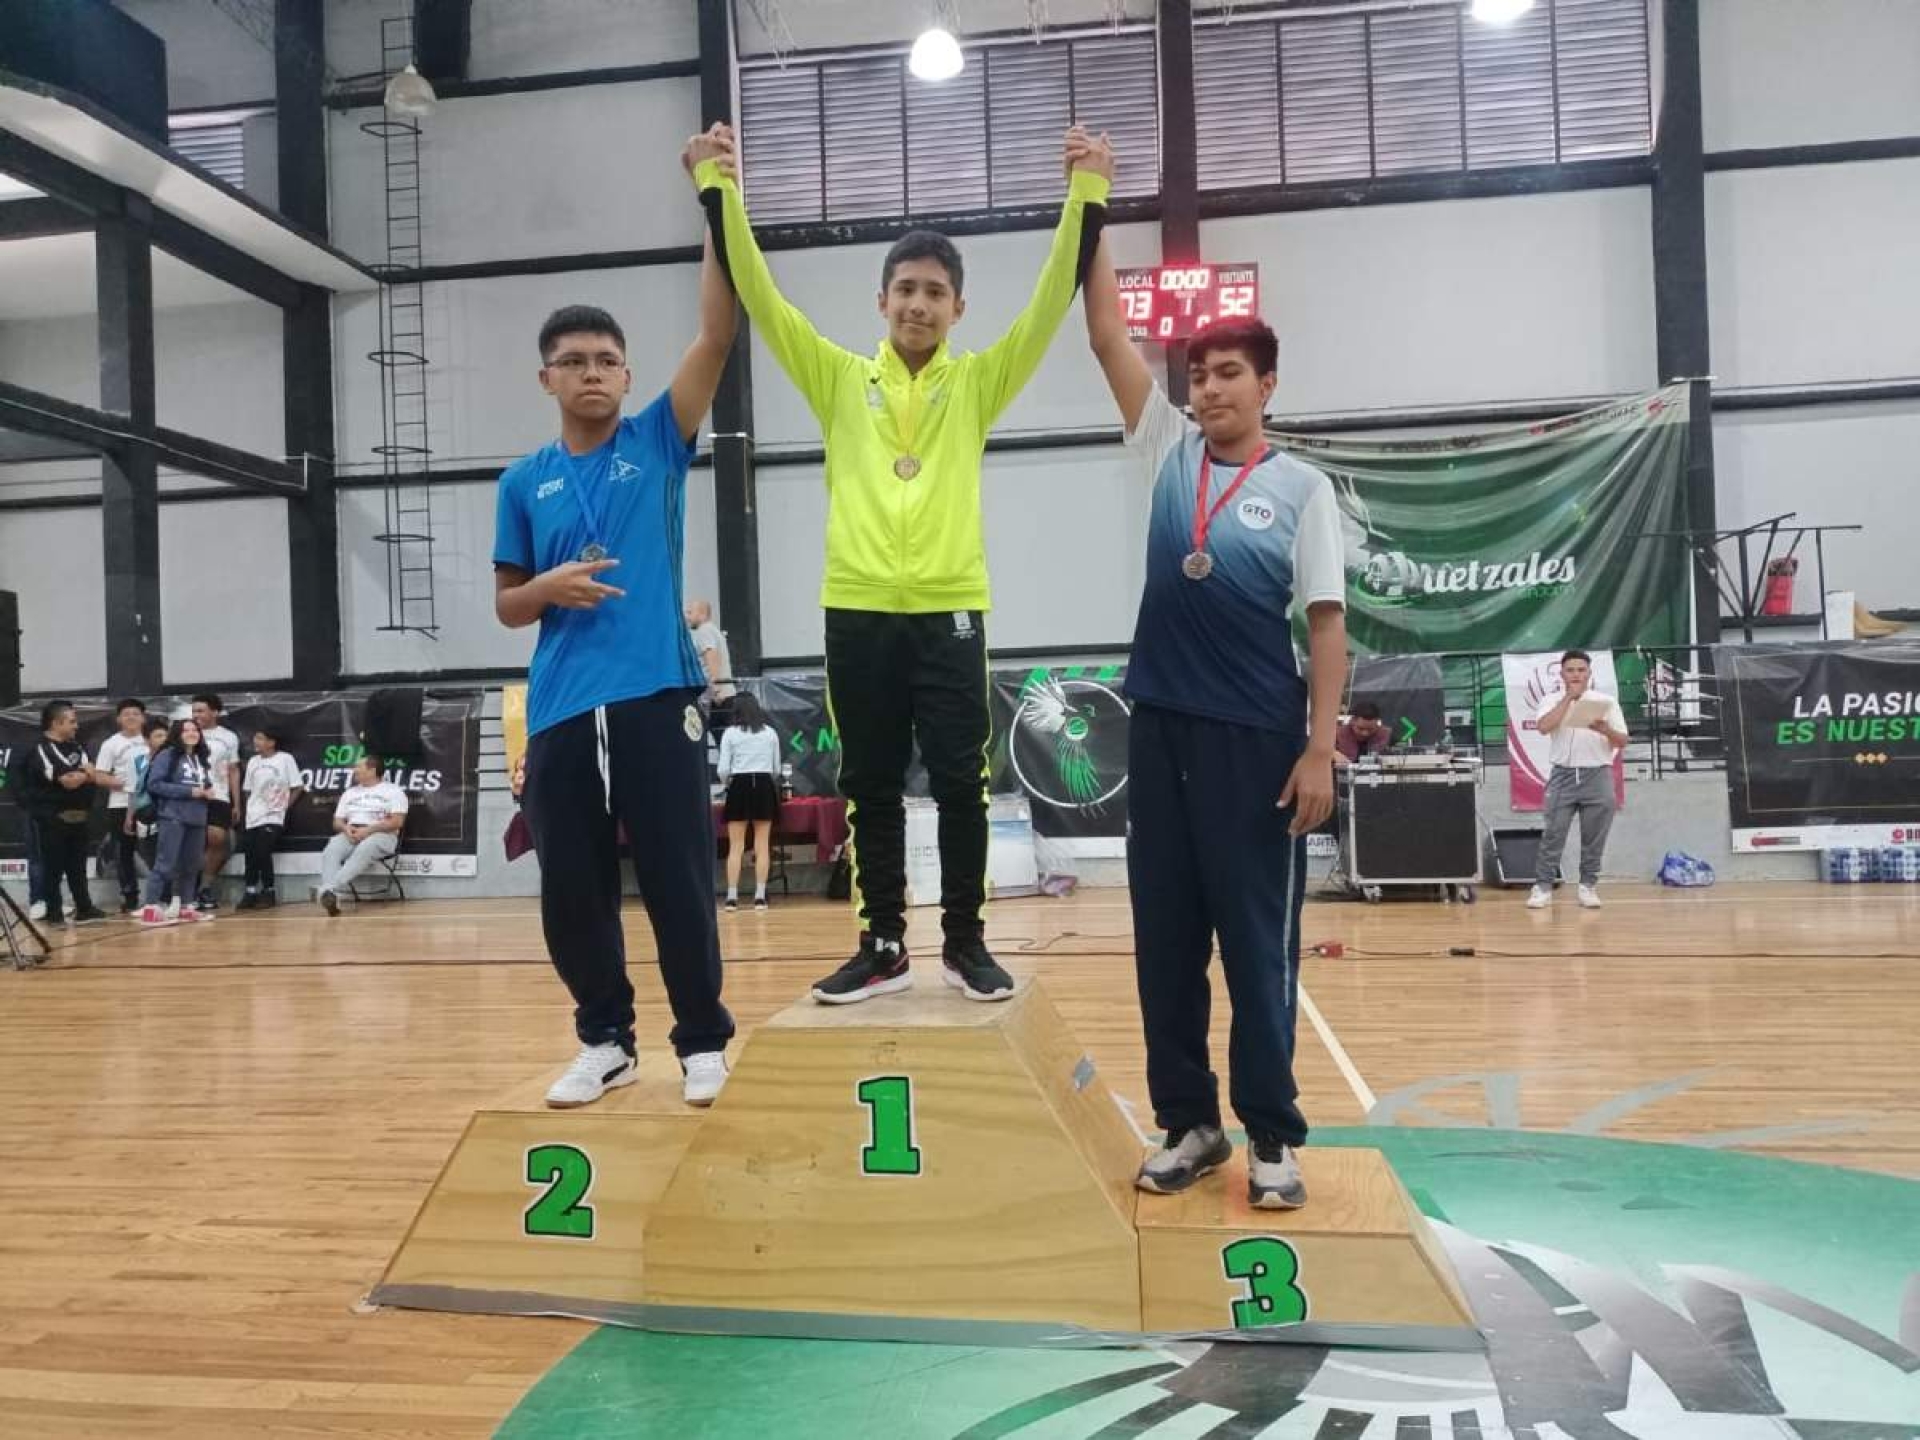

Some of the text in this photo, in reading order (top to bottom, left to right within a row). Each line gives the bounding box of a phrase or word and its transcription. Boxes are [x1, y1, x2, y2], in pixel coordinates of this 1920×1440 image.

[1119, 275, 1155, 289] LOCAL
[1119, 291, 1152, 320] 73
[1219, 286, 1255, 318] 52
[1243, 503, 1272, 520] GTO
[1793, 694, 1833, 718] LA
[1776, 721, 1817, 745] ES
[300, 768, 442, 793] QUETALES
[857, 1074, 921, 1175] 1
[524, 1143, 594, 1239] 2
[1221, 1236, 1308, 1329] 3
